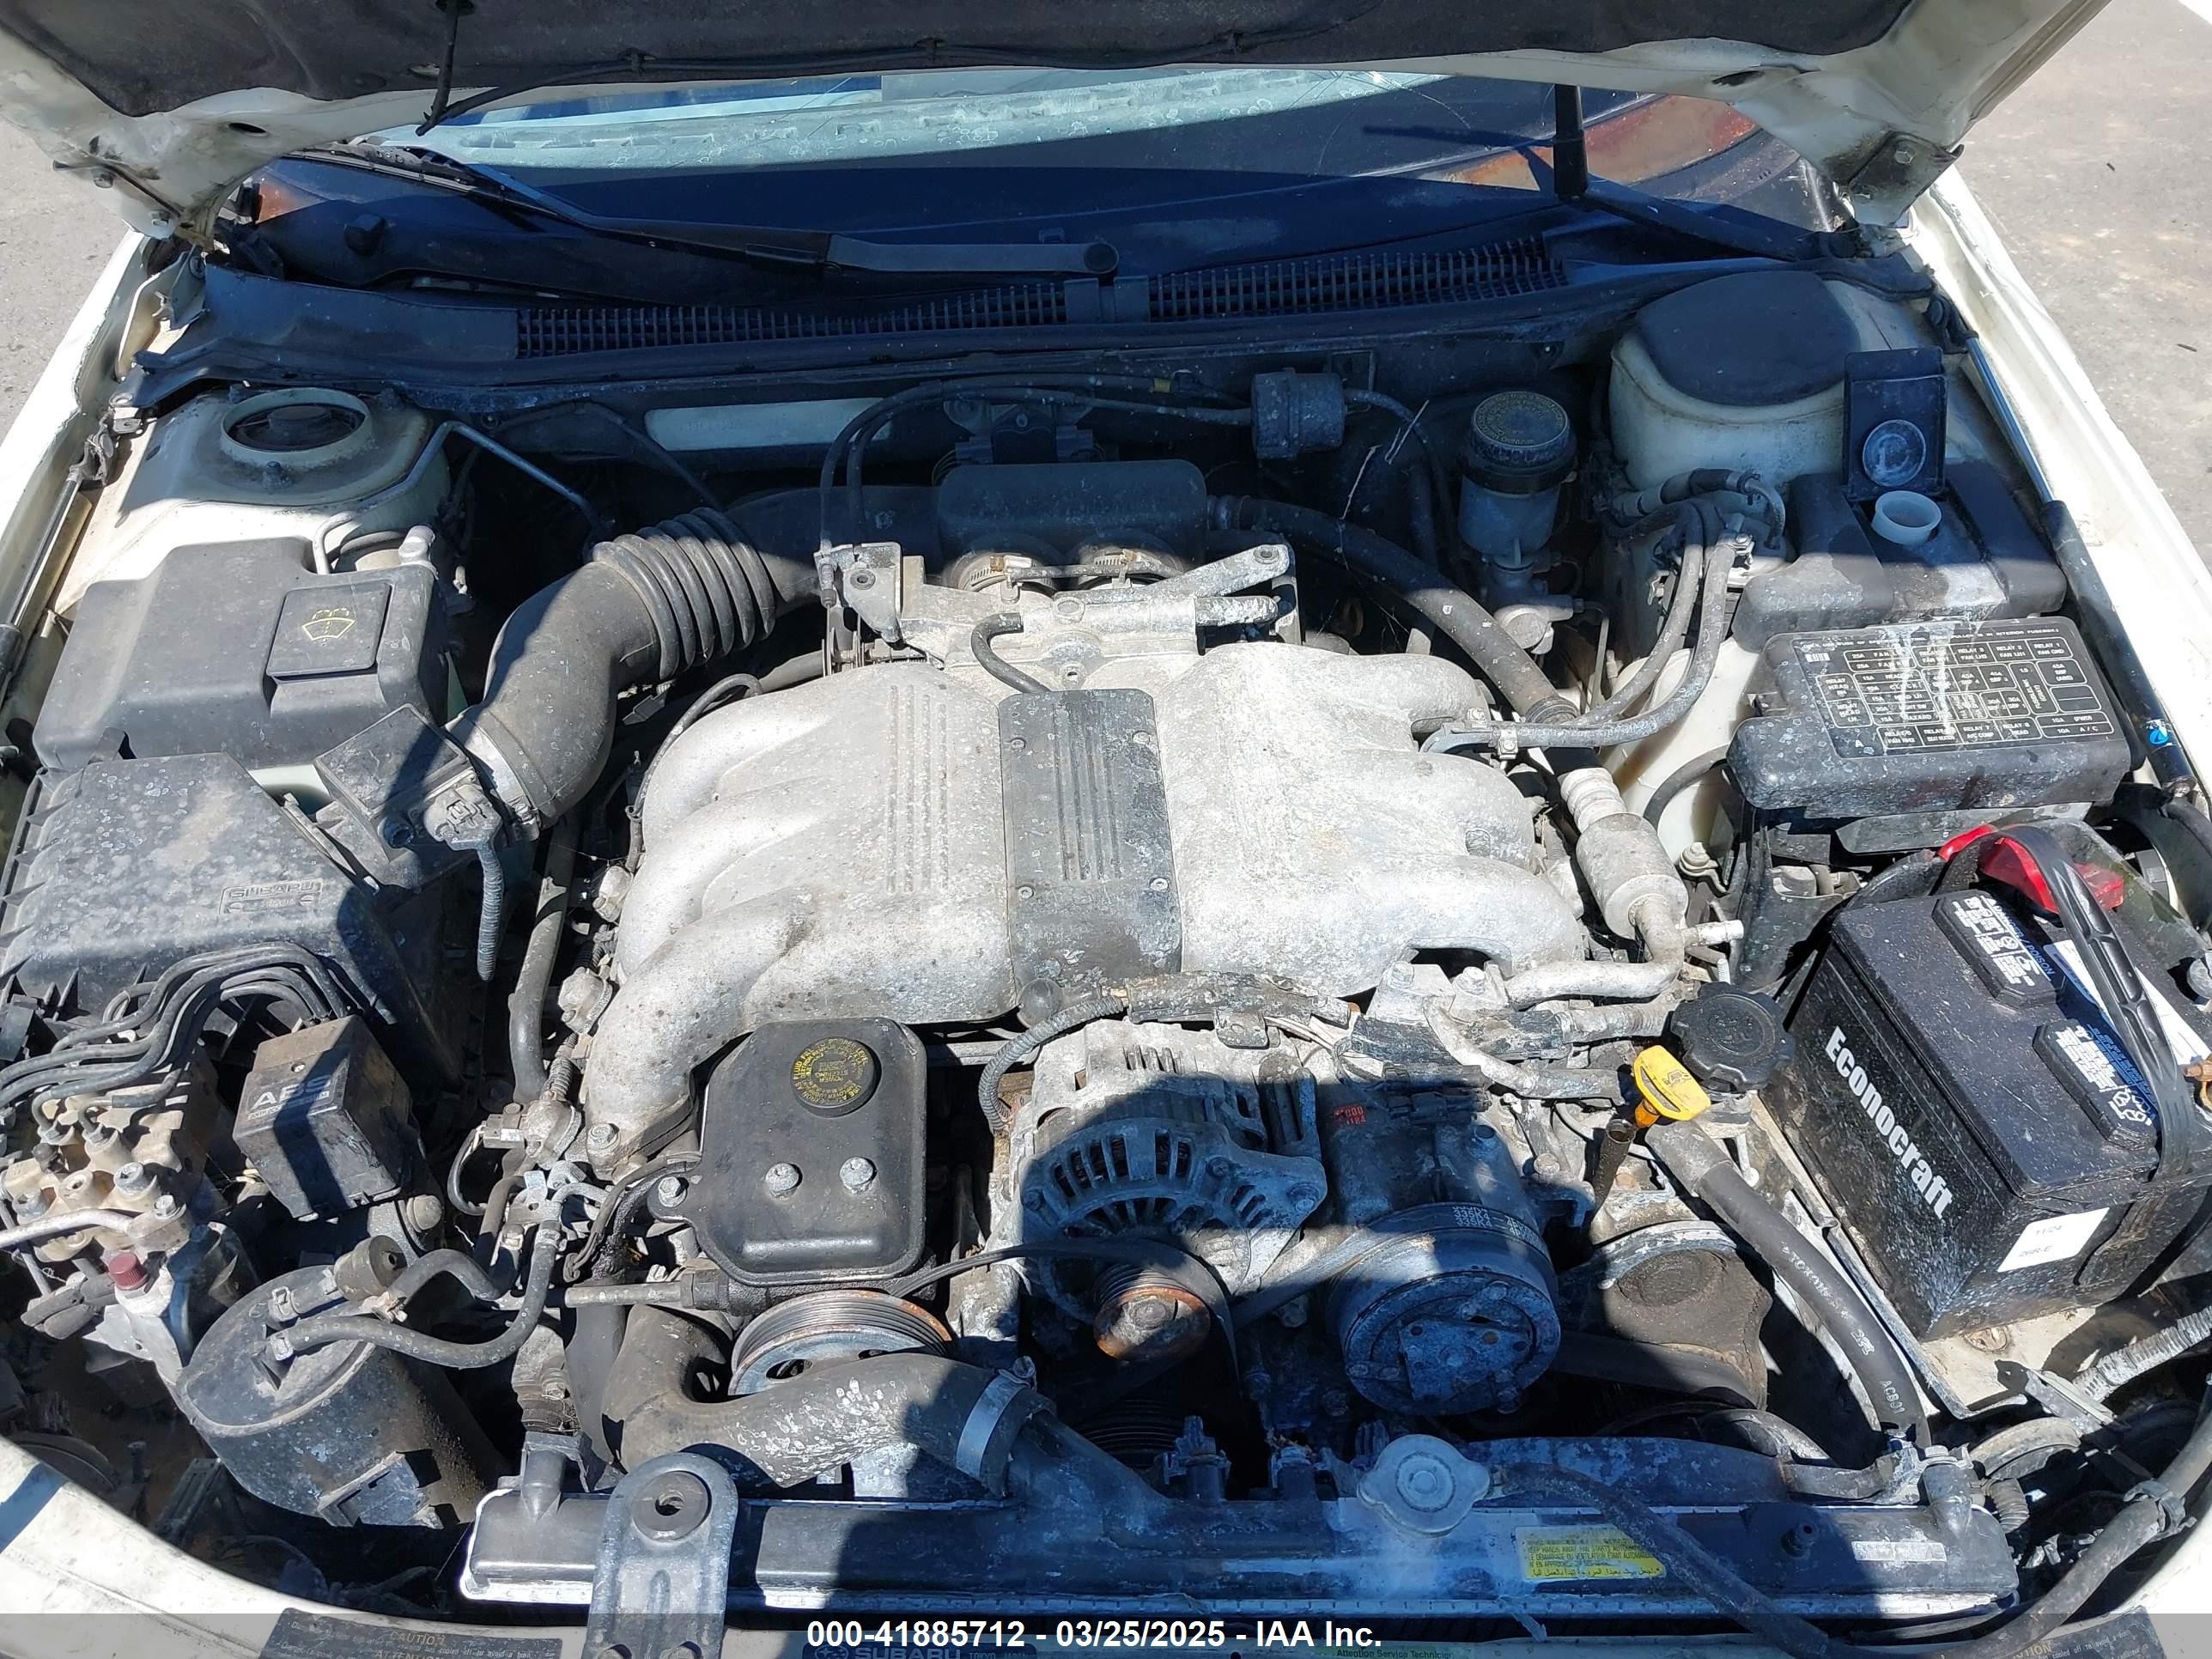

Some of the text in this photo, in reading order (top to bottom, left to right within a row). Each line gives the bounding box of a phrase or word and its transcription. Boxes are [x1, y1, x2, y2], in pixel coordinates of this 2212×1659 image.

[1855, 739, 1864, 748] A
[2026, 944, 2056, 975] POISON
[249, 1075, 331, 1111] ABS
[1825, 1025, 1953, 1219] Econocraft
[389, 1631, 446, 1646] CAUTION
[1336, 1649, 1374, 1658] Attention
[1376, 1649, 1408, 1658] Service
